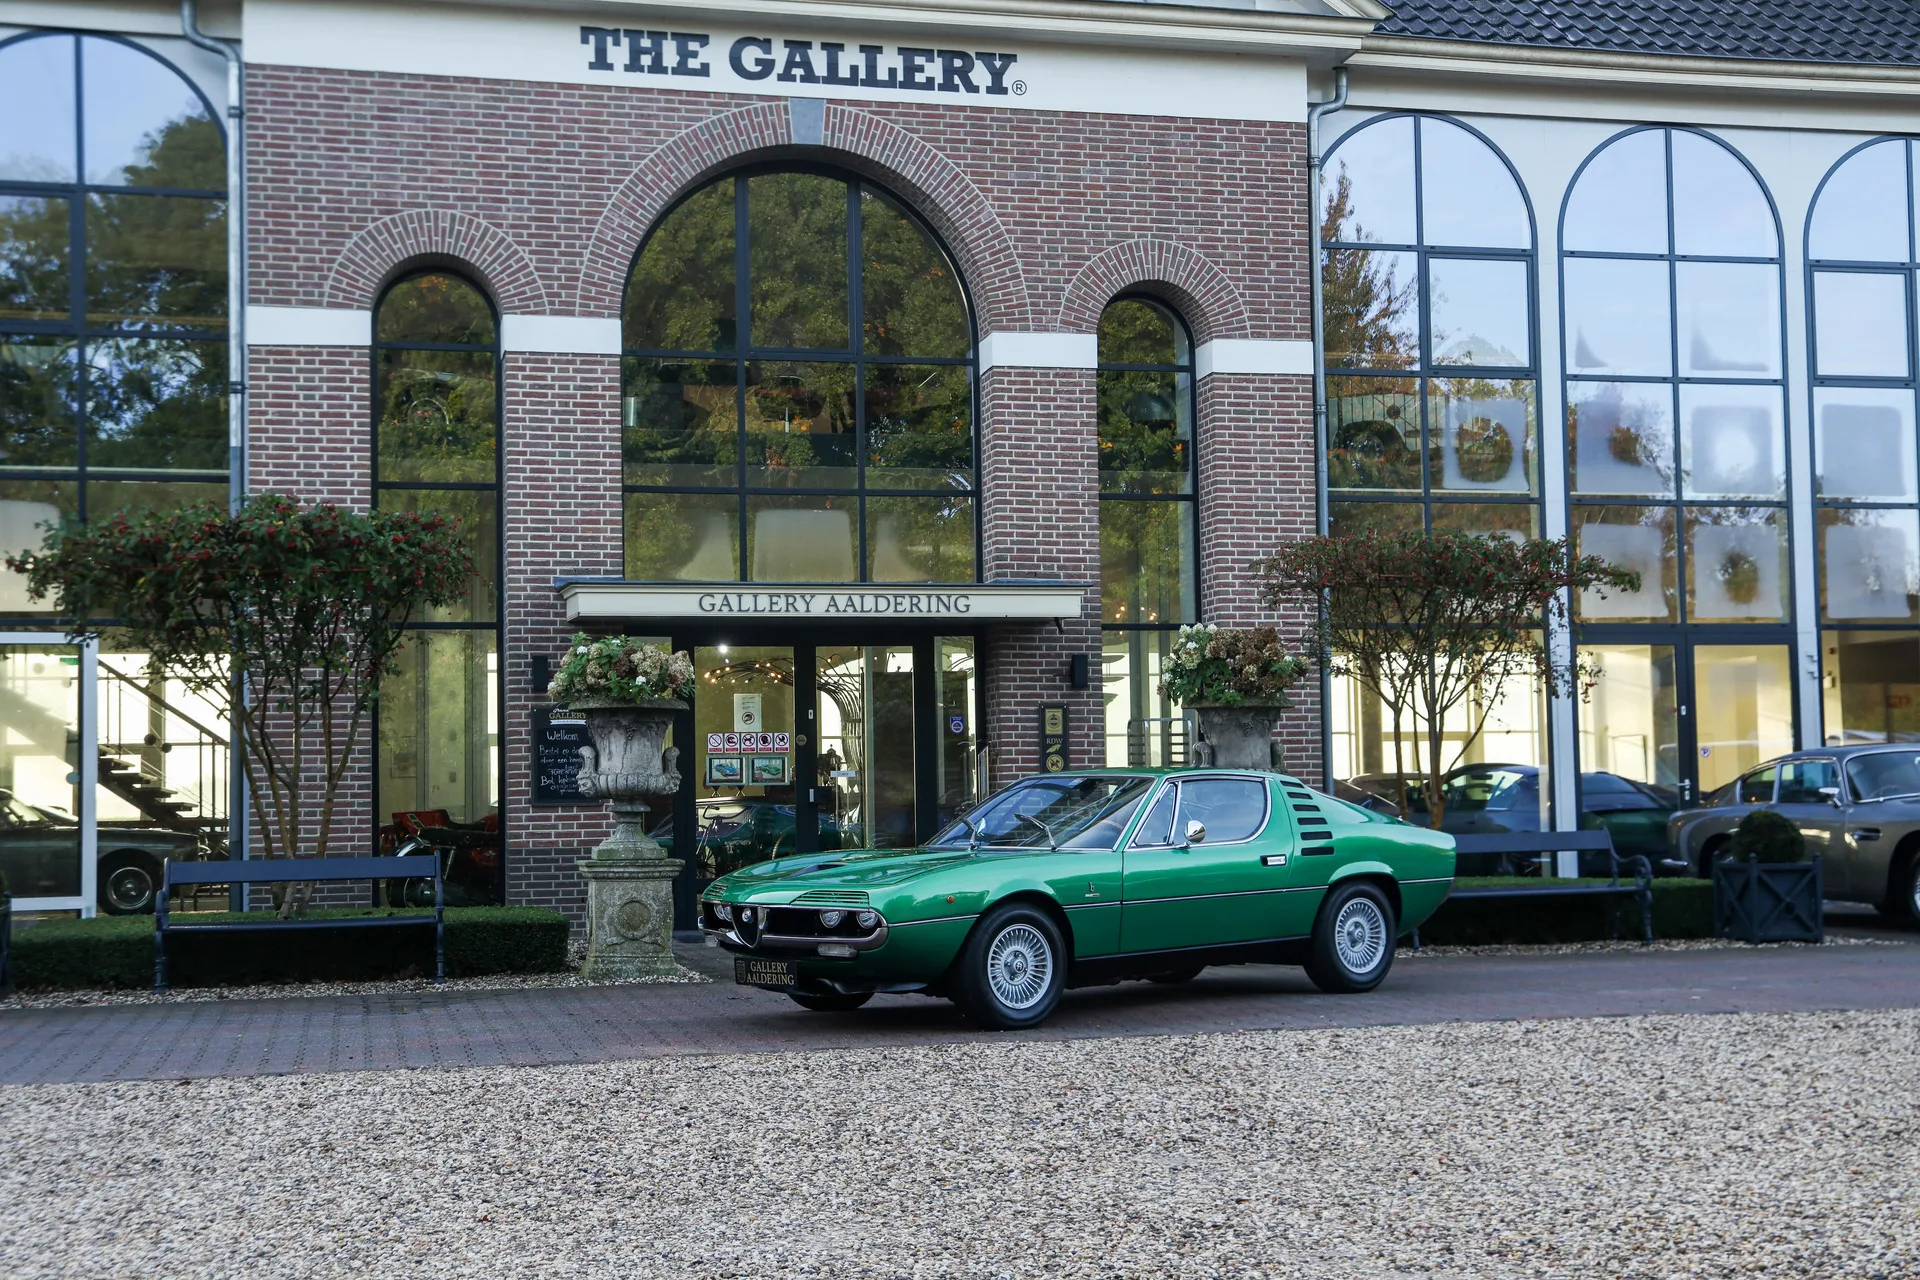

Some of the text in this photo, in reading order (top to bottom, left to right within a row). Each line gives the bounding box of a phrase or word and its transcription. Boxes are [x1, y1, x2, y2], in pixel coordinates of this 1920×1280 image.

[580, 25, 710, 78] THE
[698, 593, 971, 613] GALLERY AALDERING
[546, 729, 580, 741] Welkom
[750, 961, 788, 973] GALLERY
[746, 972, 795, 985] AALDERING
